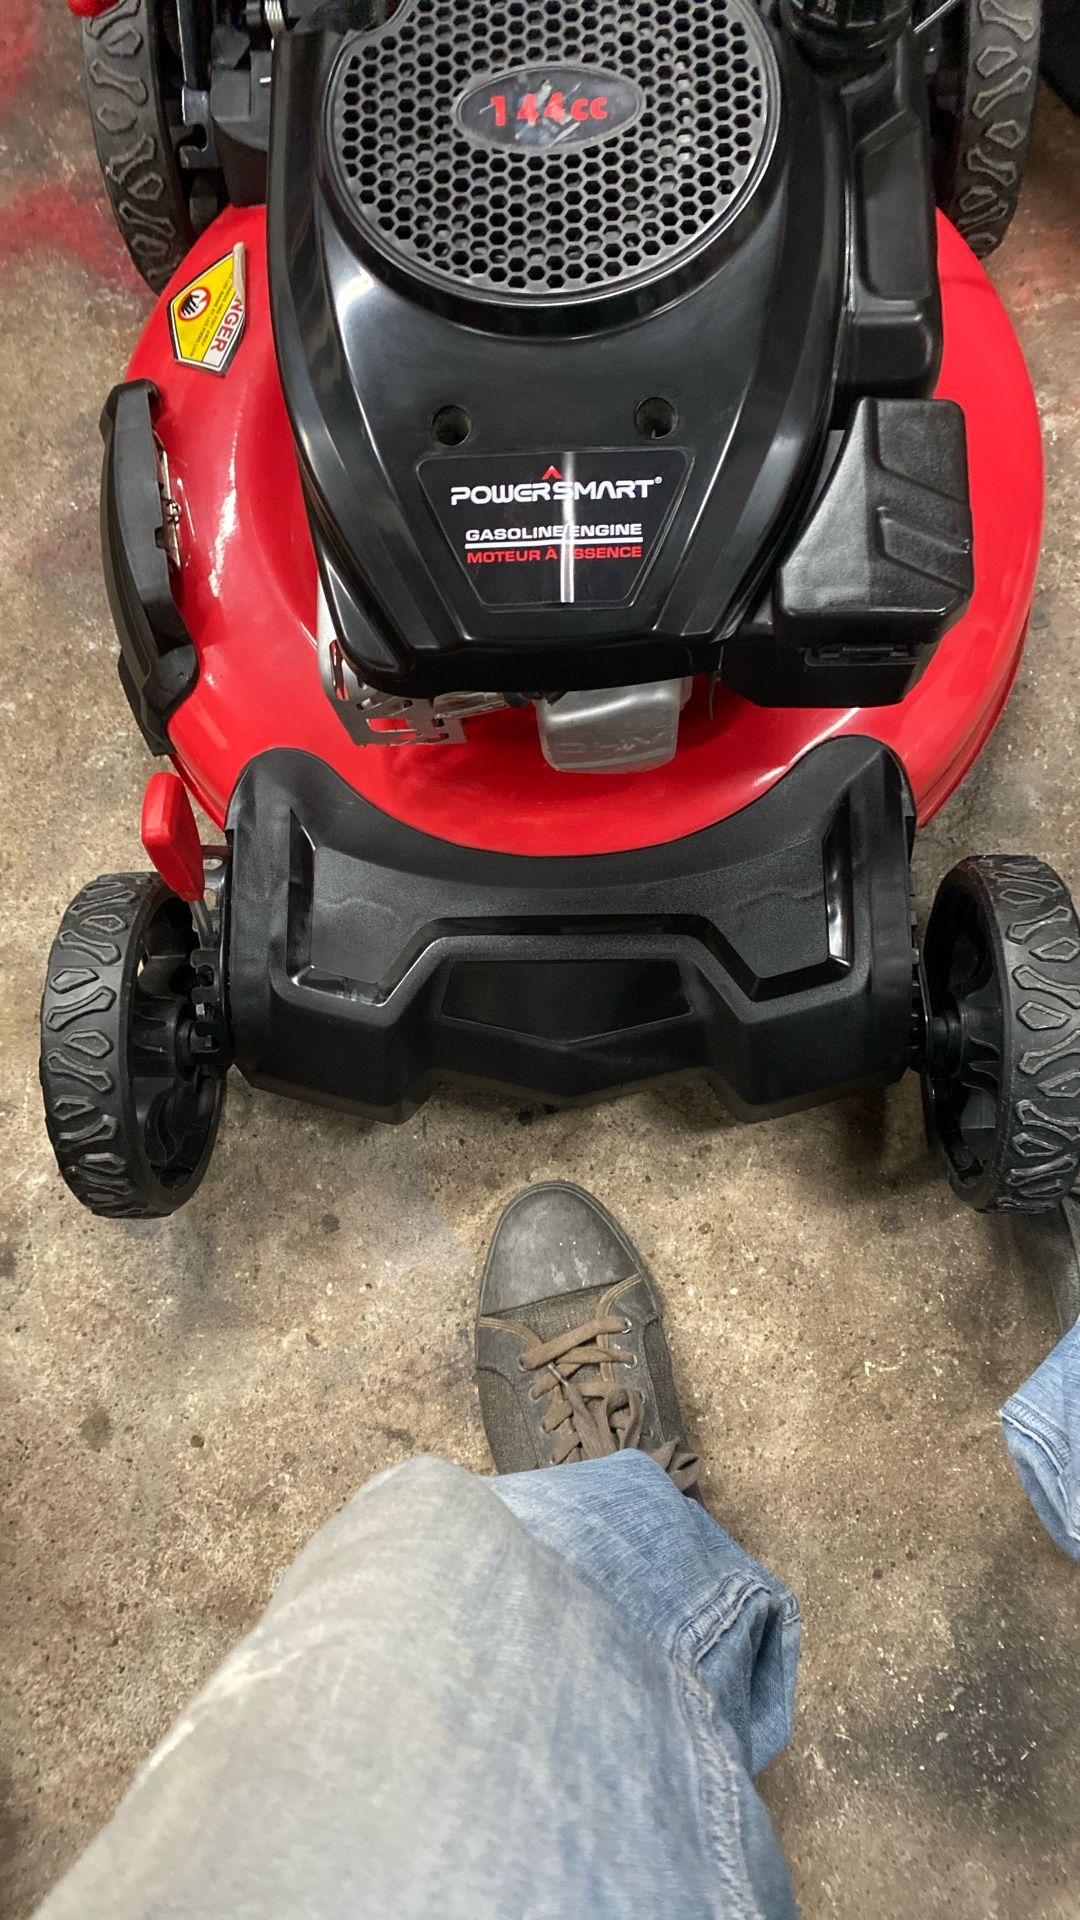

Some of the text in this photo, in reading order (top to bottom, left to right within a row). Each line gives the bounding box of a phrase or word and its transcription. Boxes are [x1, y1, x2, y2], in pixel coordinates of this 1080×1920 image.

[490, 91, 608, 127] 144cc
[211, 297, 243, 352] NGER
[465, 523, 642, 541] GASOLINE ENGINE
[467, 549, 540, 564] MOTEUR
[564, 545, 642, 560] SSENCE
